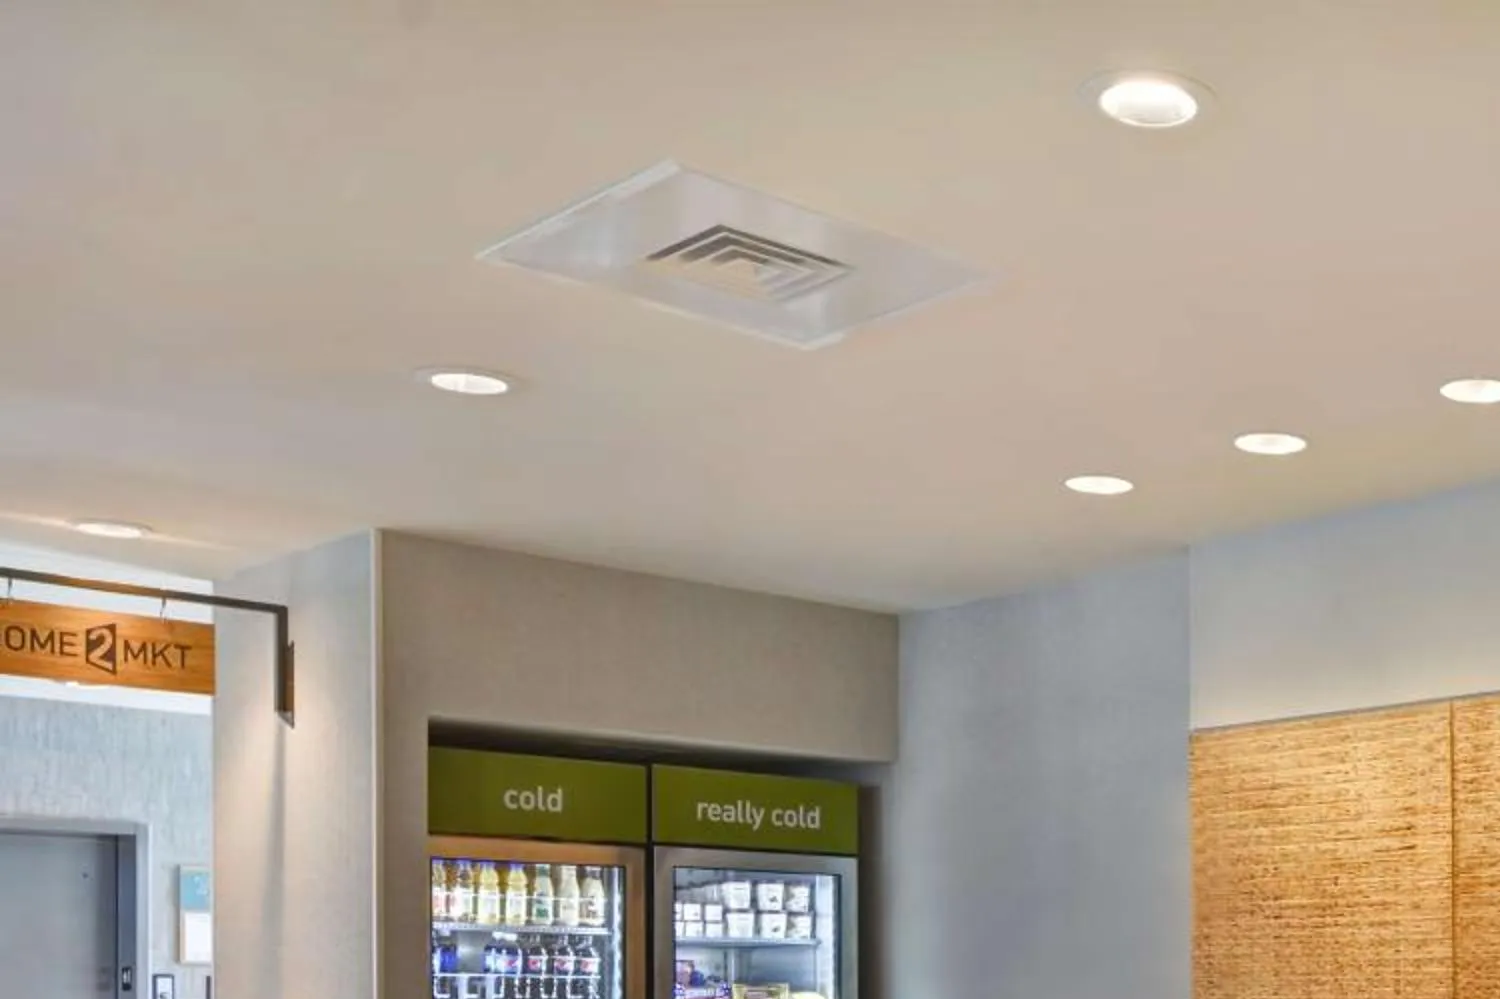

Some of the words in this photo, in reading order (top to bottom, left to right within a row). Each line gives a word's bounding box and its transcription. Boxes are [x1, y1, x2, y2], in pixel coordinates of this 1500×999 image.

[0, 624, 78, 658] OME
[87, 626, 115, 672] 2
[123, 639, 192, 670] MKT
[503, 786, 564, 813] cold
[696, 800, 764, 831] really
[771, 806, 821, 829] cold
